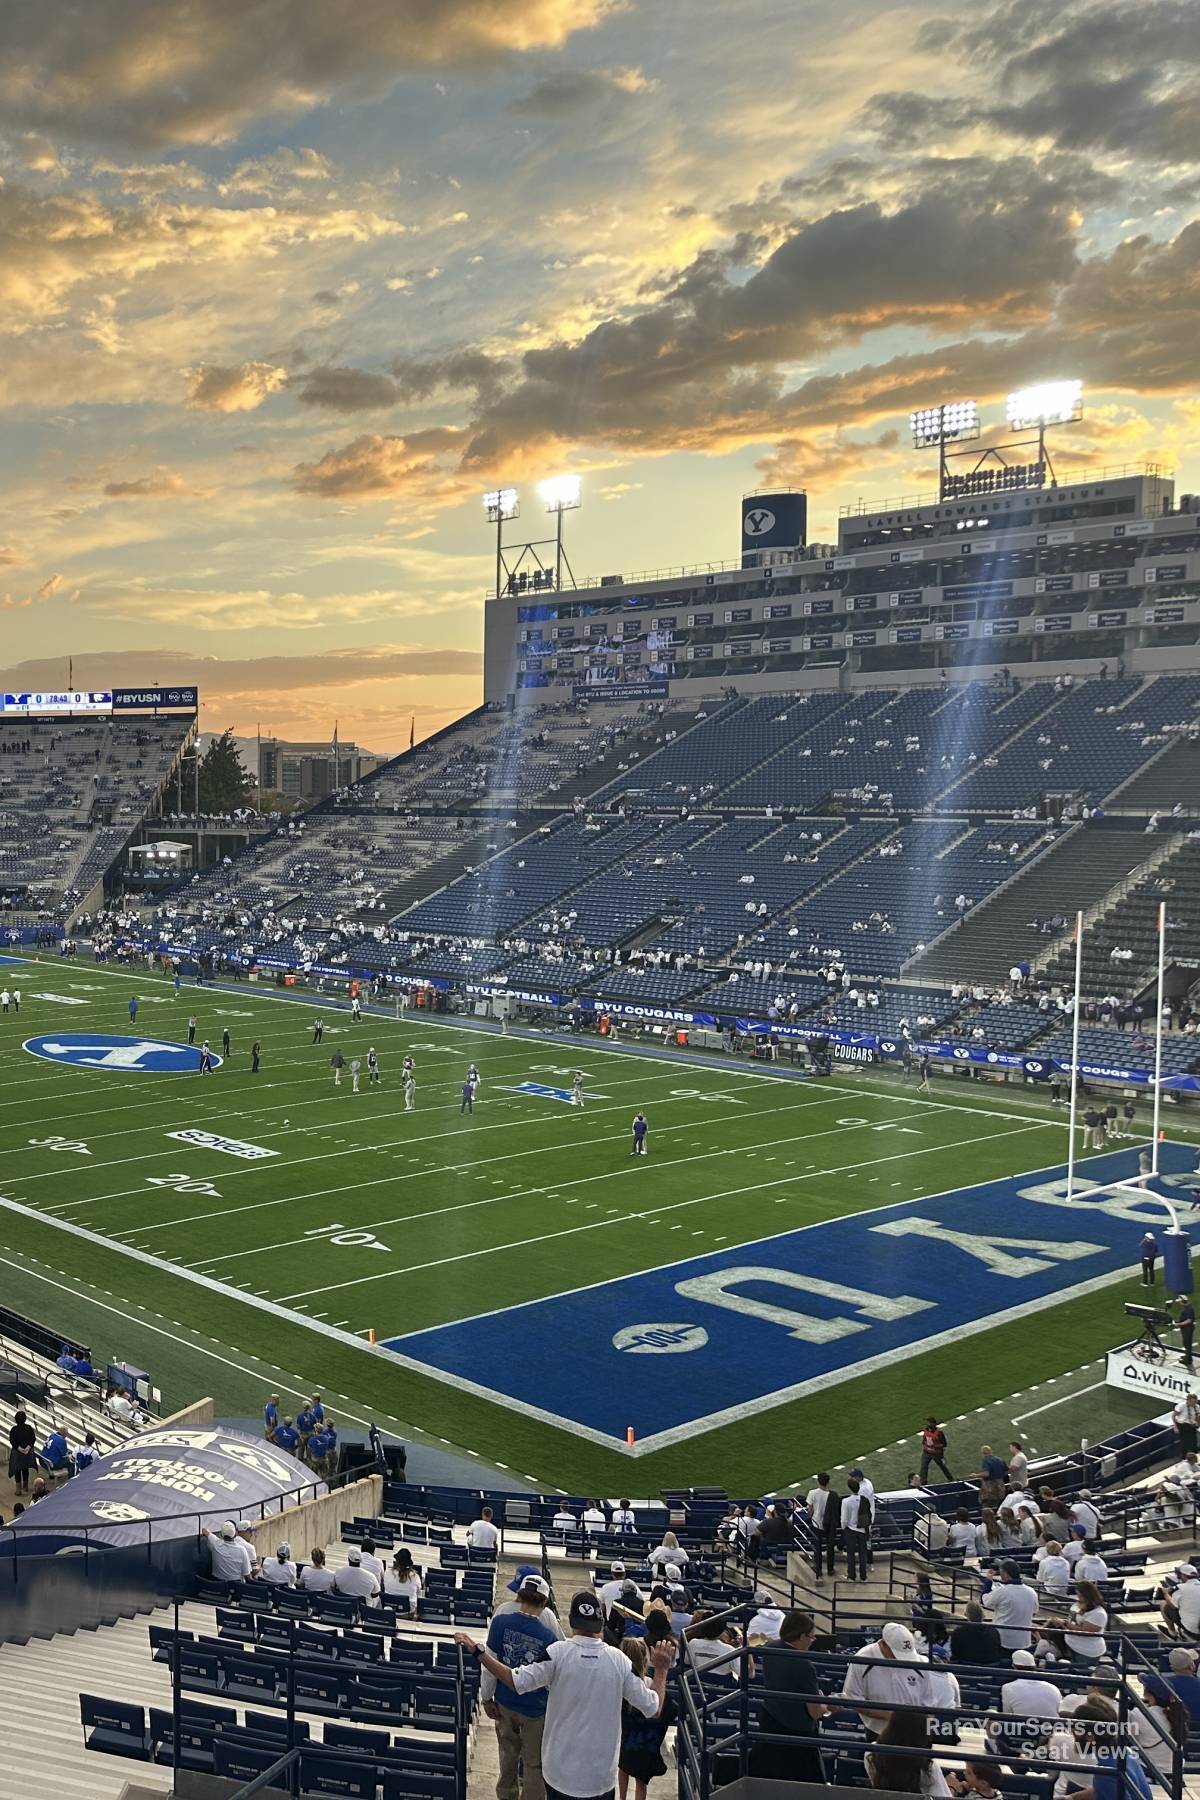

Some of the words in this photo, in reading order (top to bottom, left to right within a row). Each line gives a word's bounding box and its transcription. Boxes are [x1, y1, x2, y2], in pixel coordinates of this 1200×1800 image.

[868, 513, 922, 528] LAVELL
[935, 501, 1011, 519] EDWARDS
[1025, 488, 1106, 507] STADIUM
[116, 693, 161, 704] #BYUSN
[466, 985, 490, 995] BYU
[594, 1002, 622, 1013] BYU
[625, 1005, 694, 1022] COUGARS
[771, 1026, 789, 1034] BYU
[834, 1044, 873, 1062] COUGARS
[1082, 1065, 1130, 1078] COUGS
[28, 1136, 87, 1151] 30
[145, 1173, 215, 1194] 20
[303, 1223, 377, 1245] 10
[110, 1458, 240, 1491] FOOTBALL
[124, 1465, 154, 1473] 12
[157, 1466, 206, 1486] BIG
[133, 1472, 216, 1502] HOME
